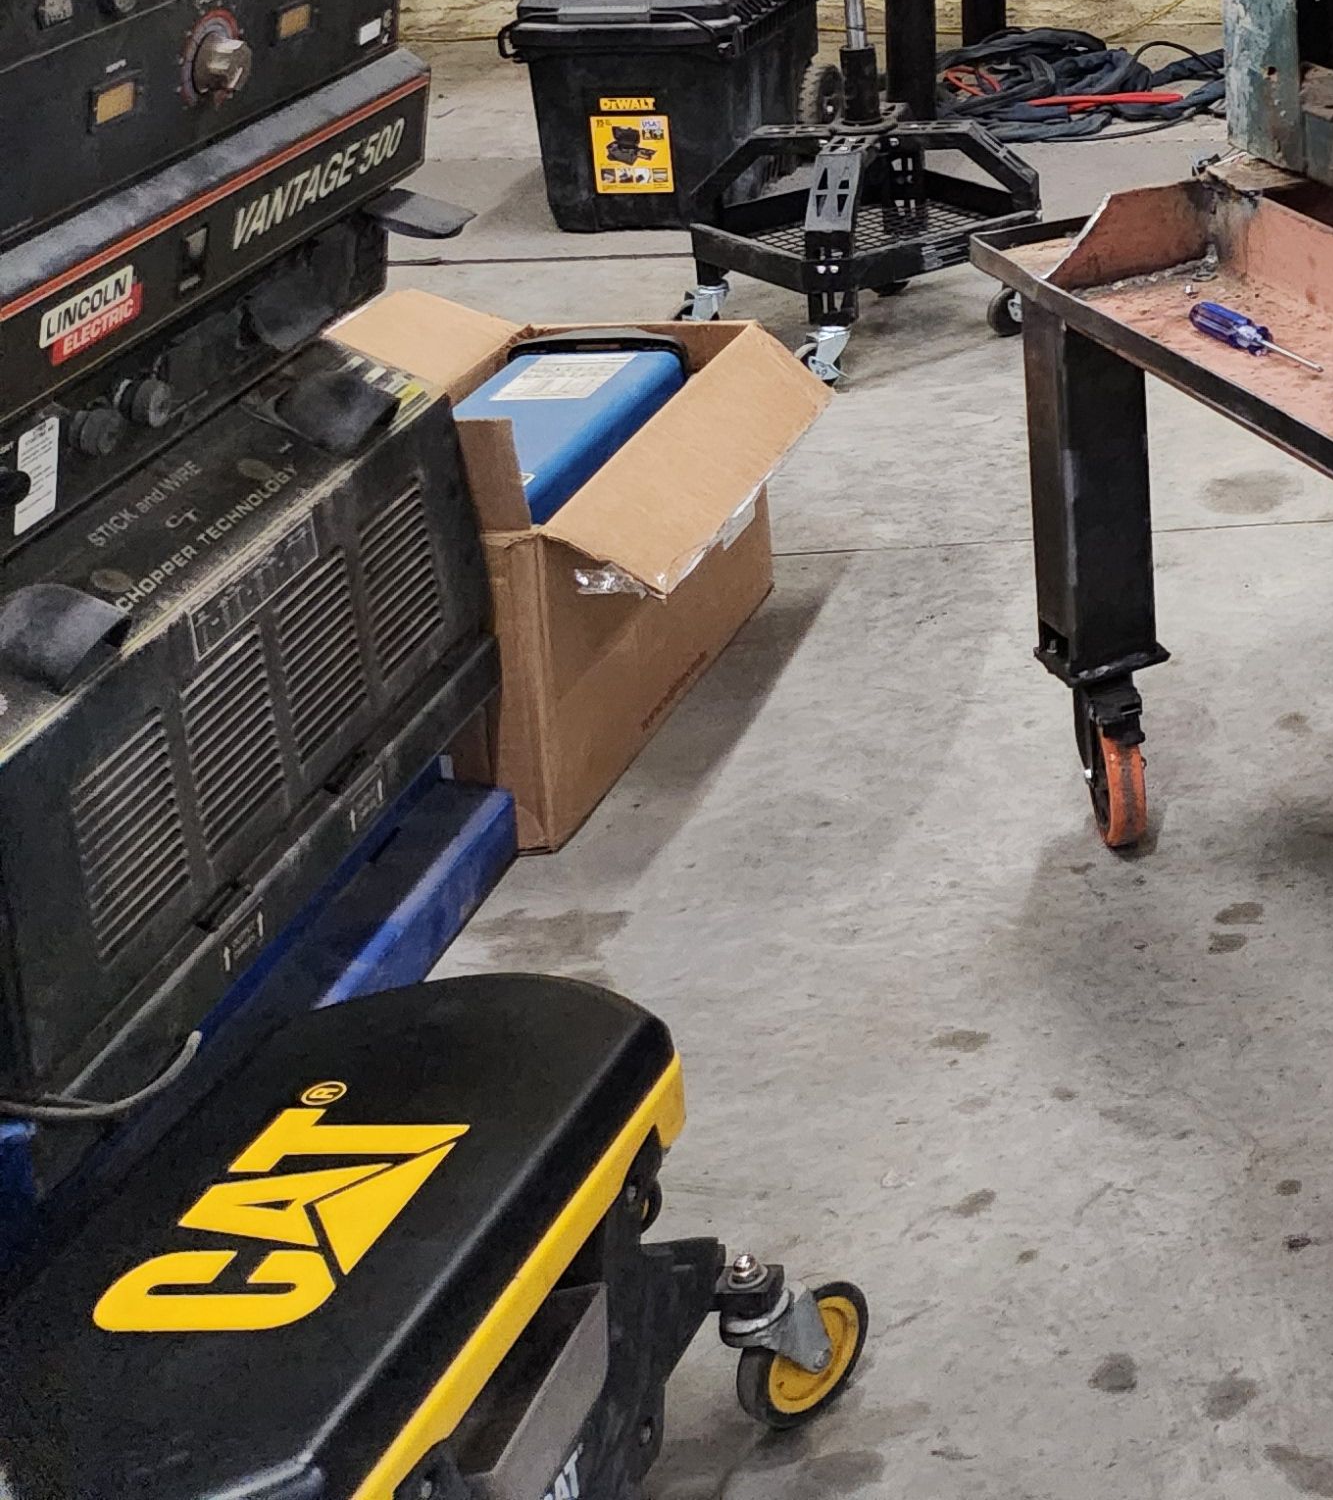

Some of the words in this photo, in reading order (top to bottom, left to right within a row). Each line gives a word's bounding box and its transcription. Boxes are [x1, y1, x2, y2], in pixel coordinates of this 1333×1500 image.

[600, 98, 656, 111] DEWALT
[232, 141, 362, 250] VANTAGE
[358, 117, 406, 175] 500
[46, 274, 128, 341] LINCOLN
[63, 298, 135, 356] ELECTRIC
[88, 508, 139, 548] STICK
[136, 487, 165, 515] and
[161, 459, 203, 497] WIRE
[115, 544, 199, 614] CHOPPER
[197, 464, 299, 546] TECHNOLOGY
[93, 1107, 470, 1332] CAT
[544, 1447, 584, 1500] AT
